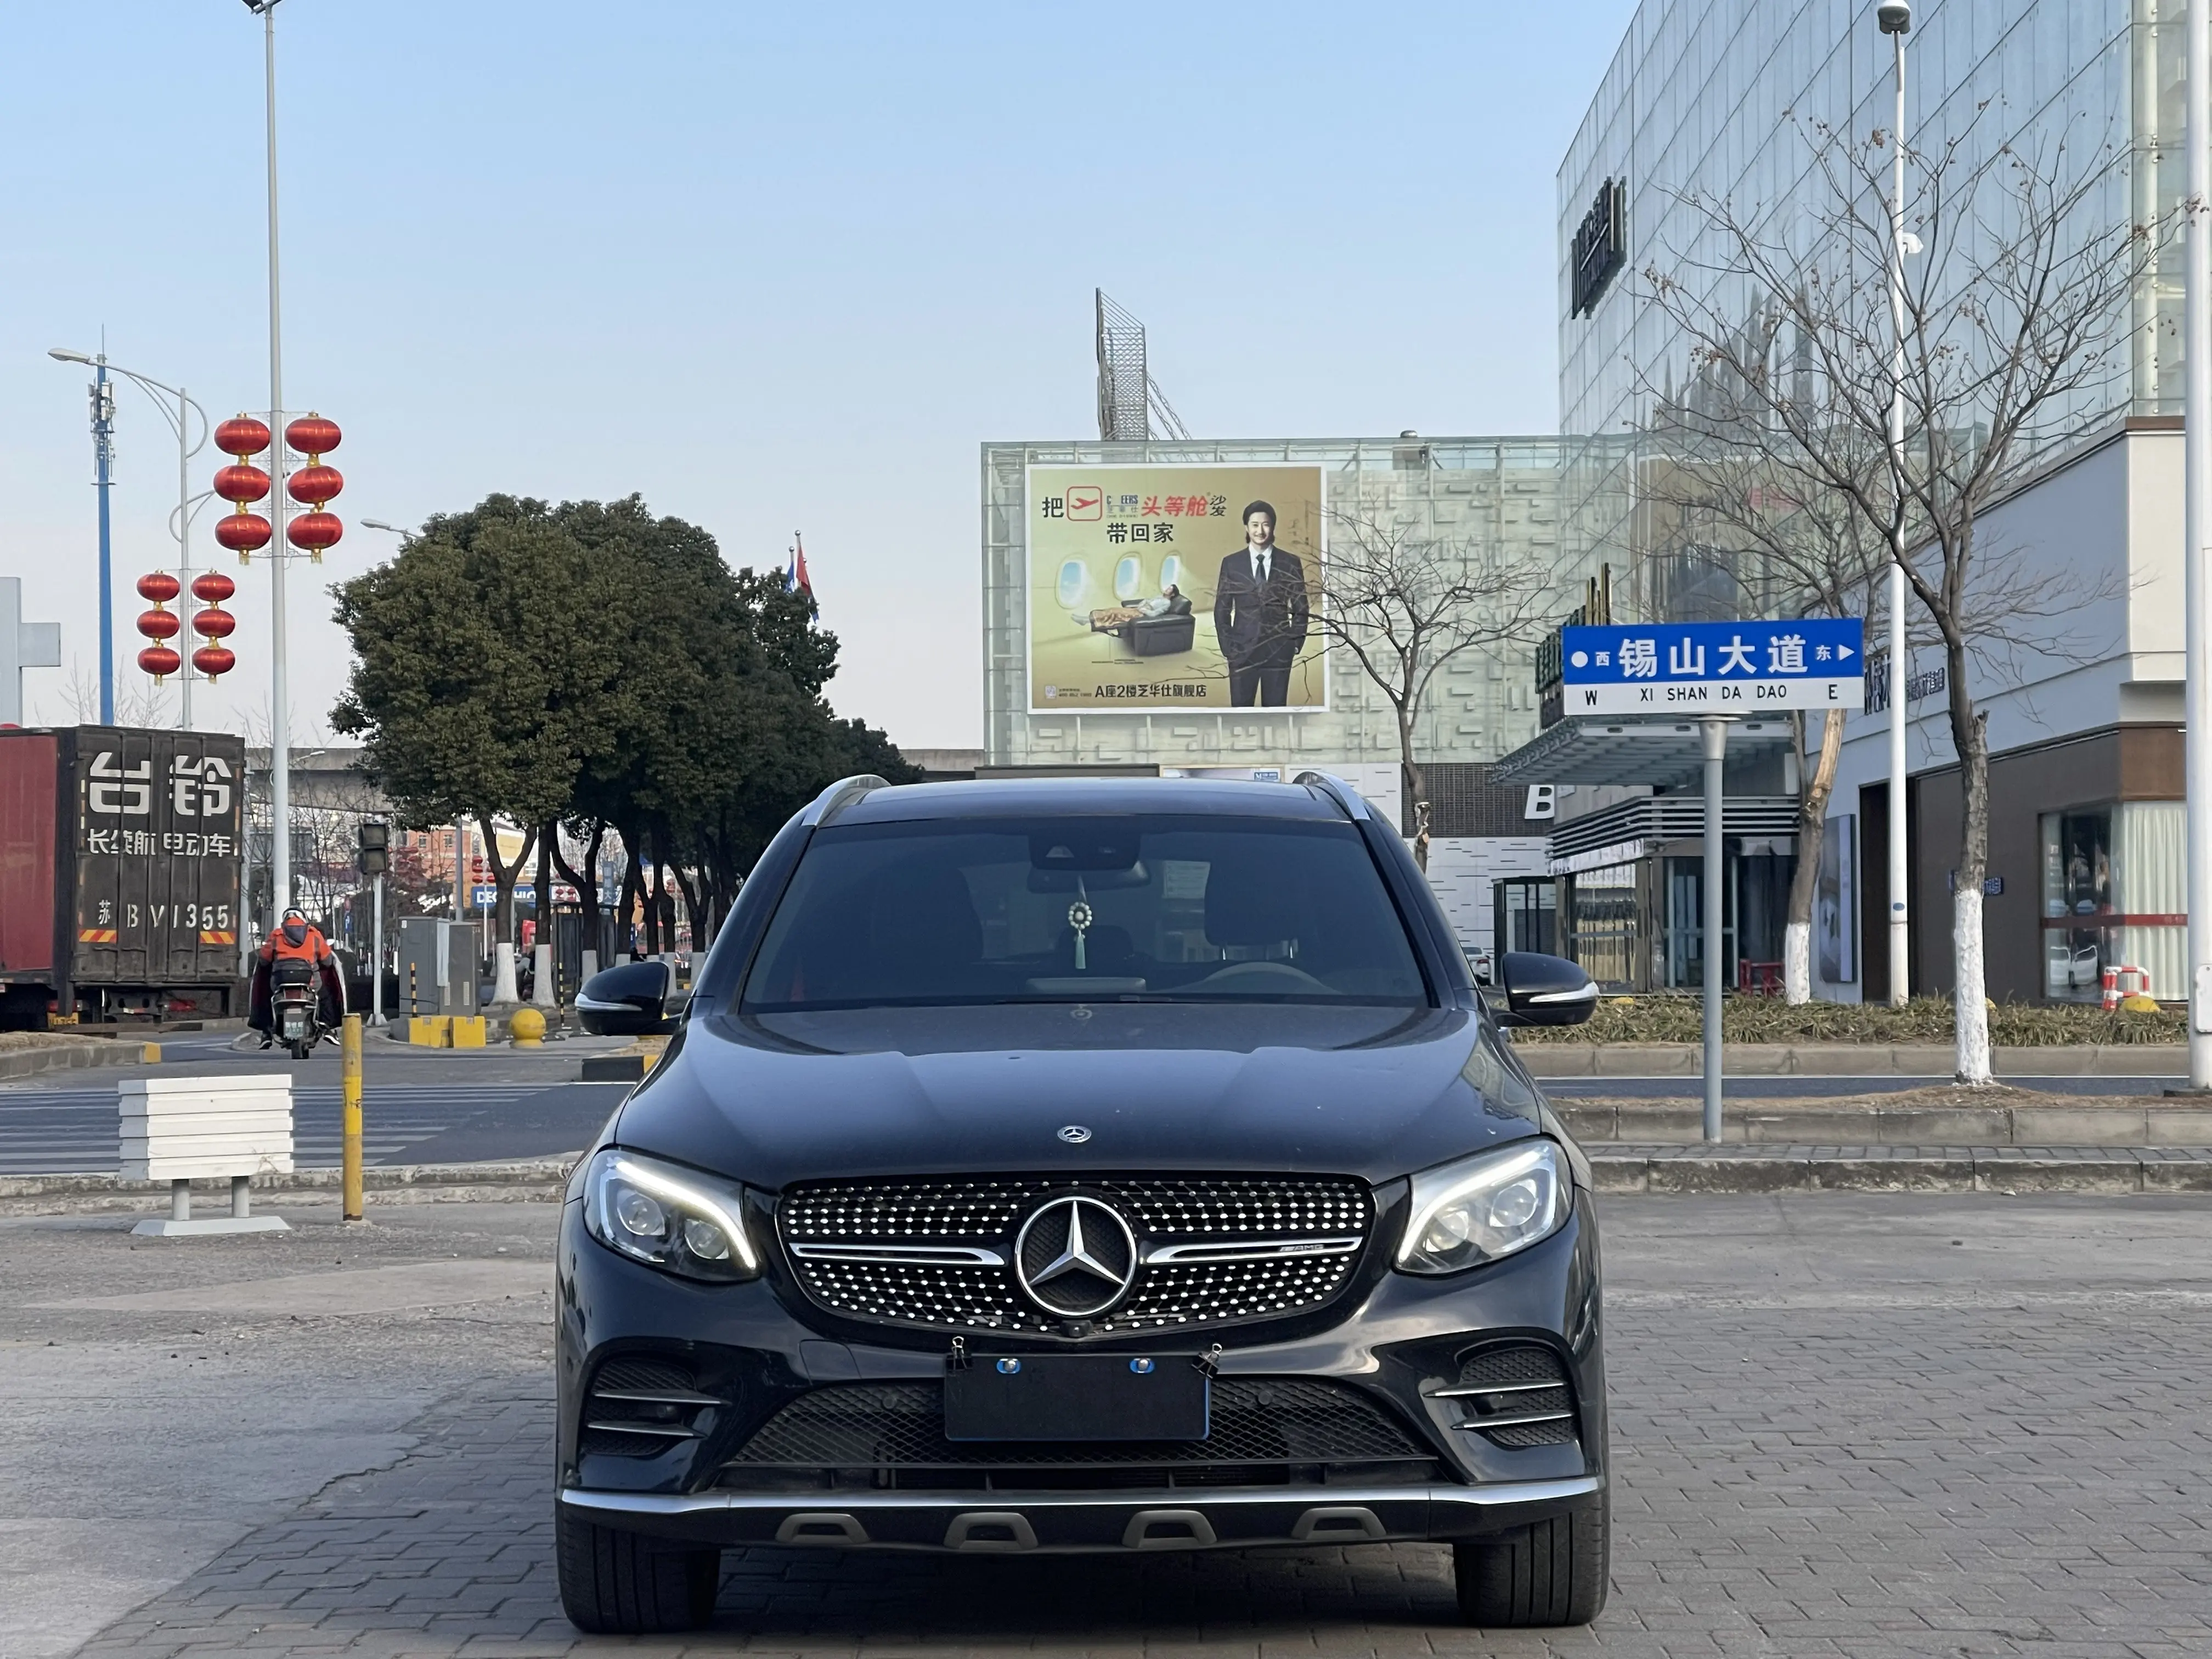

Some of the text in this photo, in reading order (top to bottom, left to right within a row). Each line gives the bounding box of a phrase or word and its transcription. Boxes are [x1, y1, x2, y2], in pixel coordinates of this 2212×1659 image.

[1042, 496, 1064, 518] 把
[1141, 495, 1227, 517] 头等舱 沙发
[1107, 522, 1174, 544] 带回家
[1595, 634, 1832, 678] 西 锡山大道 东
[1095, 684, 1207, 698] A座2楼芝华仕旗舰店
[1585, 684, 1838, 706] W XI SHAN DA DAO E
[89, 752, 232, 816] 台铃
[1525, 785, 1555, 819] B
[87, 828, 230, 857] 长续航 电动车
